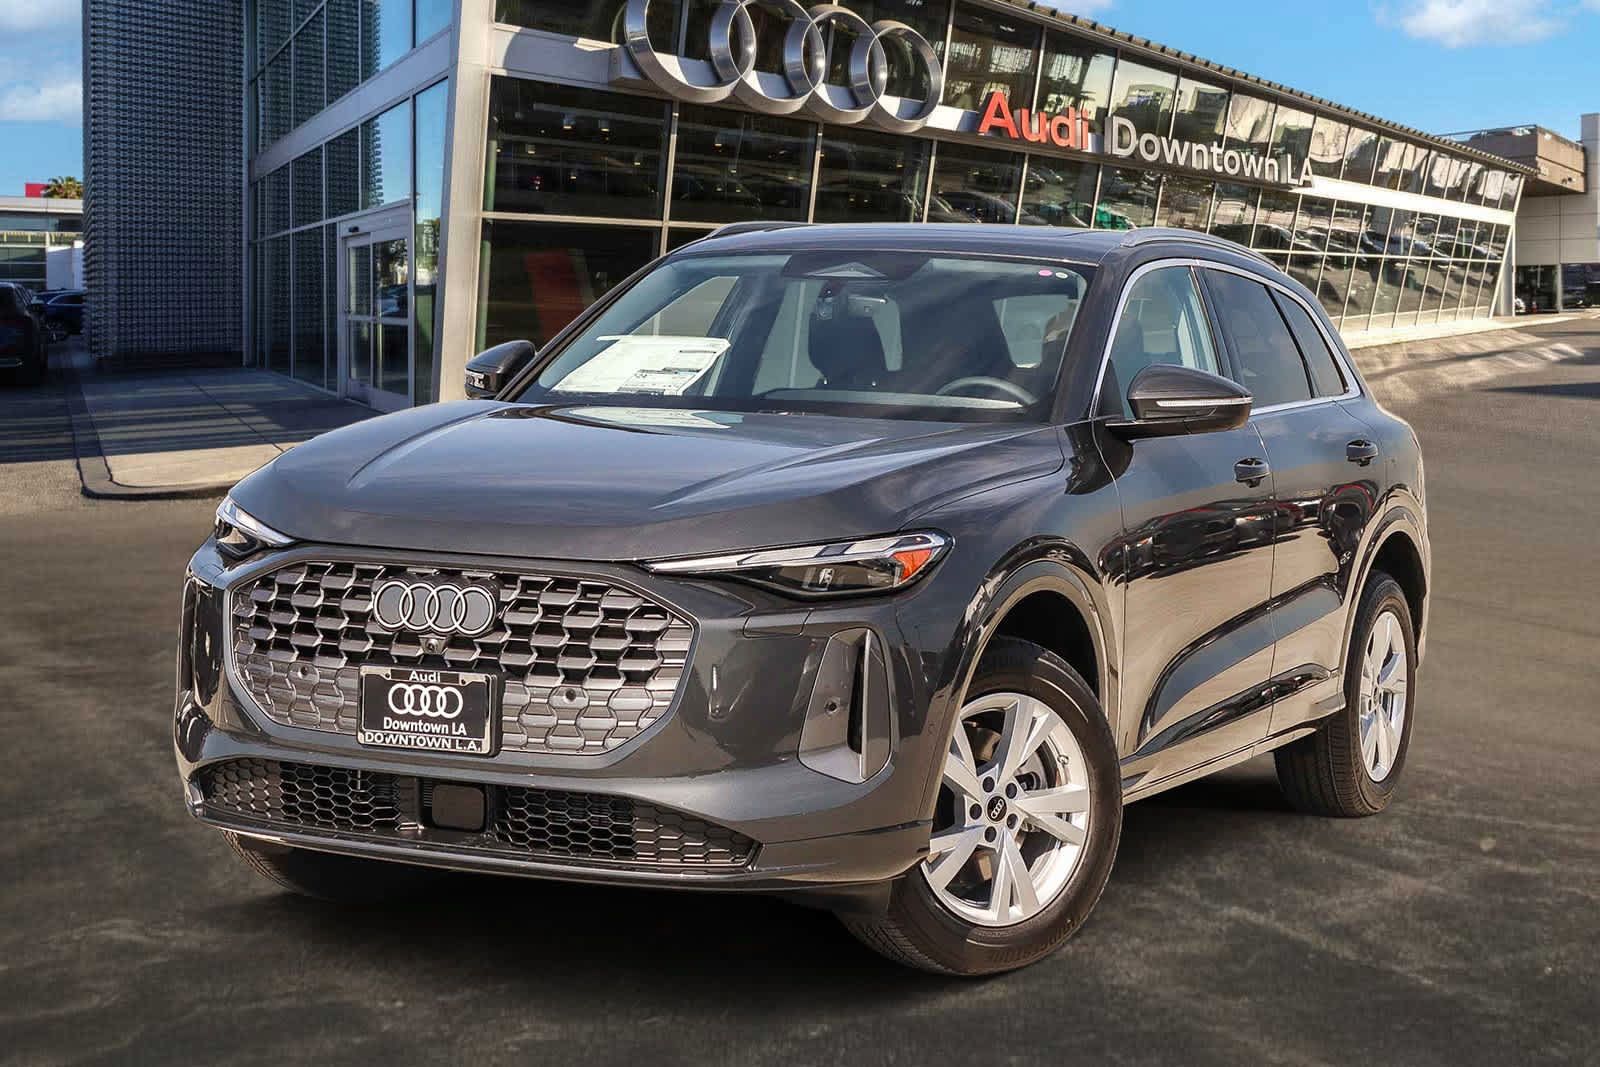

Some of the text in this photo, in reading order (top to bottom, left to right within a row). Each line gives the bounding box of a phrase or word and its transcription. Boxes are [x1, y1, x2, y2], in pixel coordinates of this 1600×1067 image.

[977, 91, 1315, 188] Audi Downtown LA
[409, 670, 441, 683] Audi
[383, 717, 467, 736] Downtown LA
[365, 732, 482, 751] DOWNTOWN L.A.
